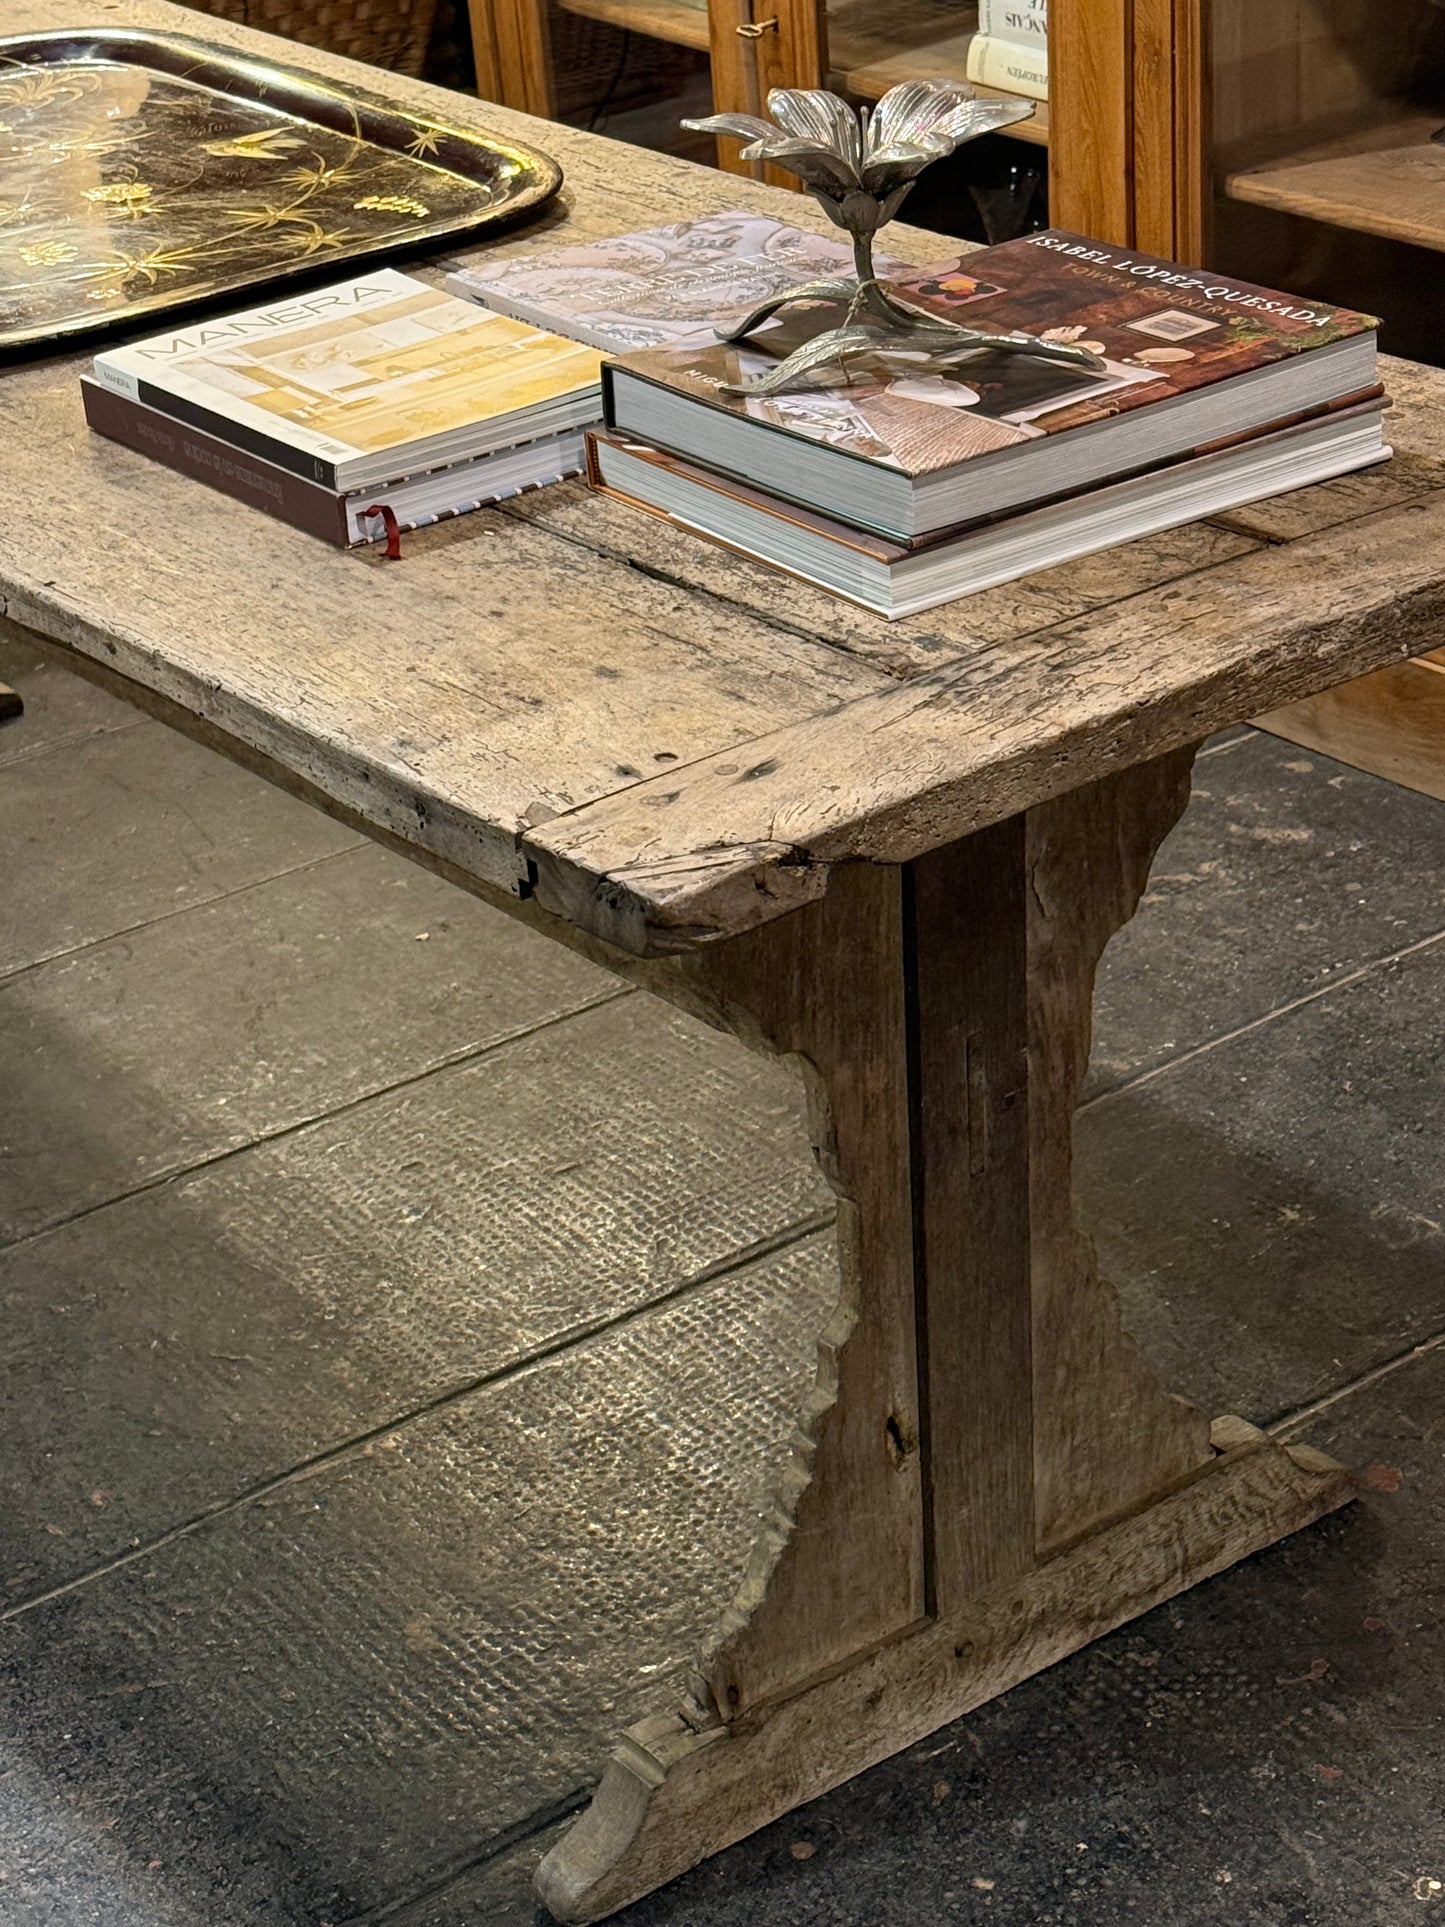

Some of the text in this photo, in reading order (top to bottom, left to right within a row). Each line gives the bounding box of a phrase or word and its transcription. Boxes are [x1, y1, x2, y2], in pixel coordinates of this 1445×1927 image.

[1026, 235, 1332, 328] ISABEL LÓPEZ-QUESADA
[1061, 263, 1241, 316] TOWN & COUNTRY
[136, 286, 392, 360] MANERA
